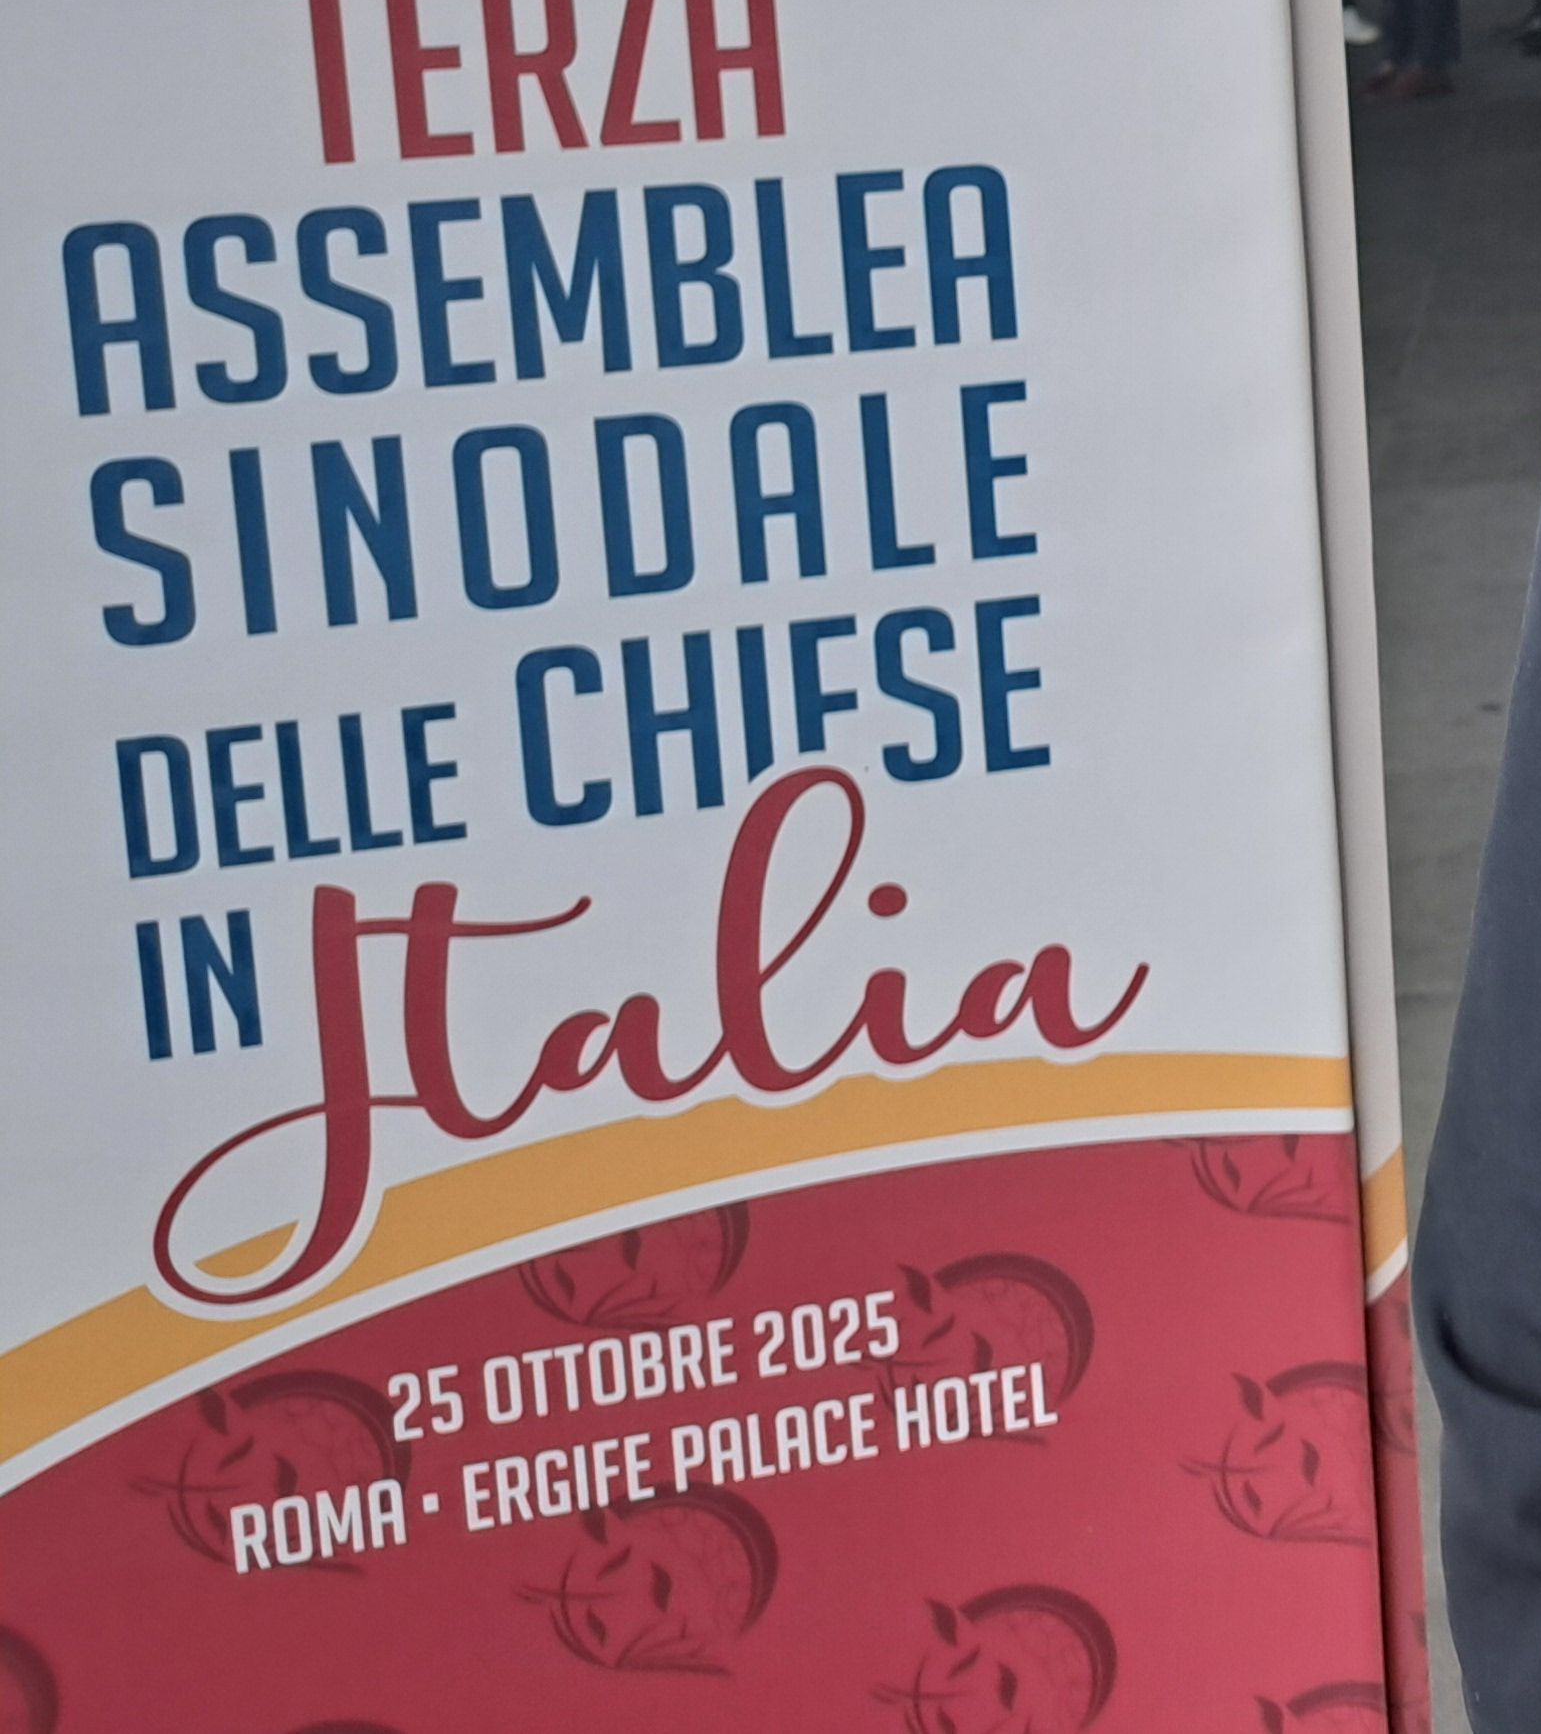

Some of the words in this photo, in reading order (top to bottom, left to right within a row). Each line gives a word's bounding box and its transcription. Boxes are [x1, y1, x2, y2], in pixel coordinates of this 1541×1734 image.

[62, 164, 1019, 416] ASSEMBLEA
[89, 380, 1038, 648] SINODALE
[115, 703, 467, 878] DELLE
[136, 911, 264, 1061] IN
[154, 768, 1149, 1304] Italia
[230, 1479, 406, 1574] ROMA
[463, 1433, 655, 1531] ERGIFE
[672, 1394, 879, 1493] PALACE
[895, 1363, 1058, 1452] HOTEL
[389, 1374, 464, 1441] 25
[484, 1319, 738, 1424] OTTOBRE
[754, 1291, 899, 1378] 2025
